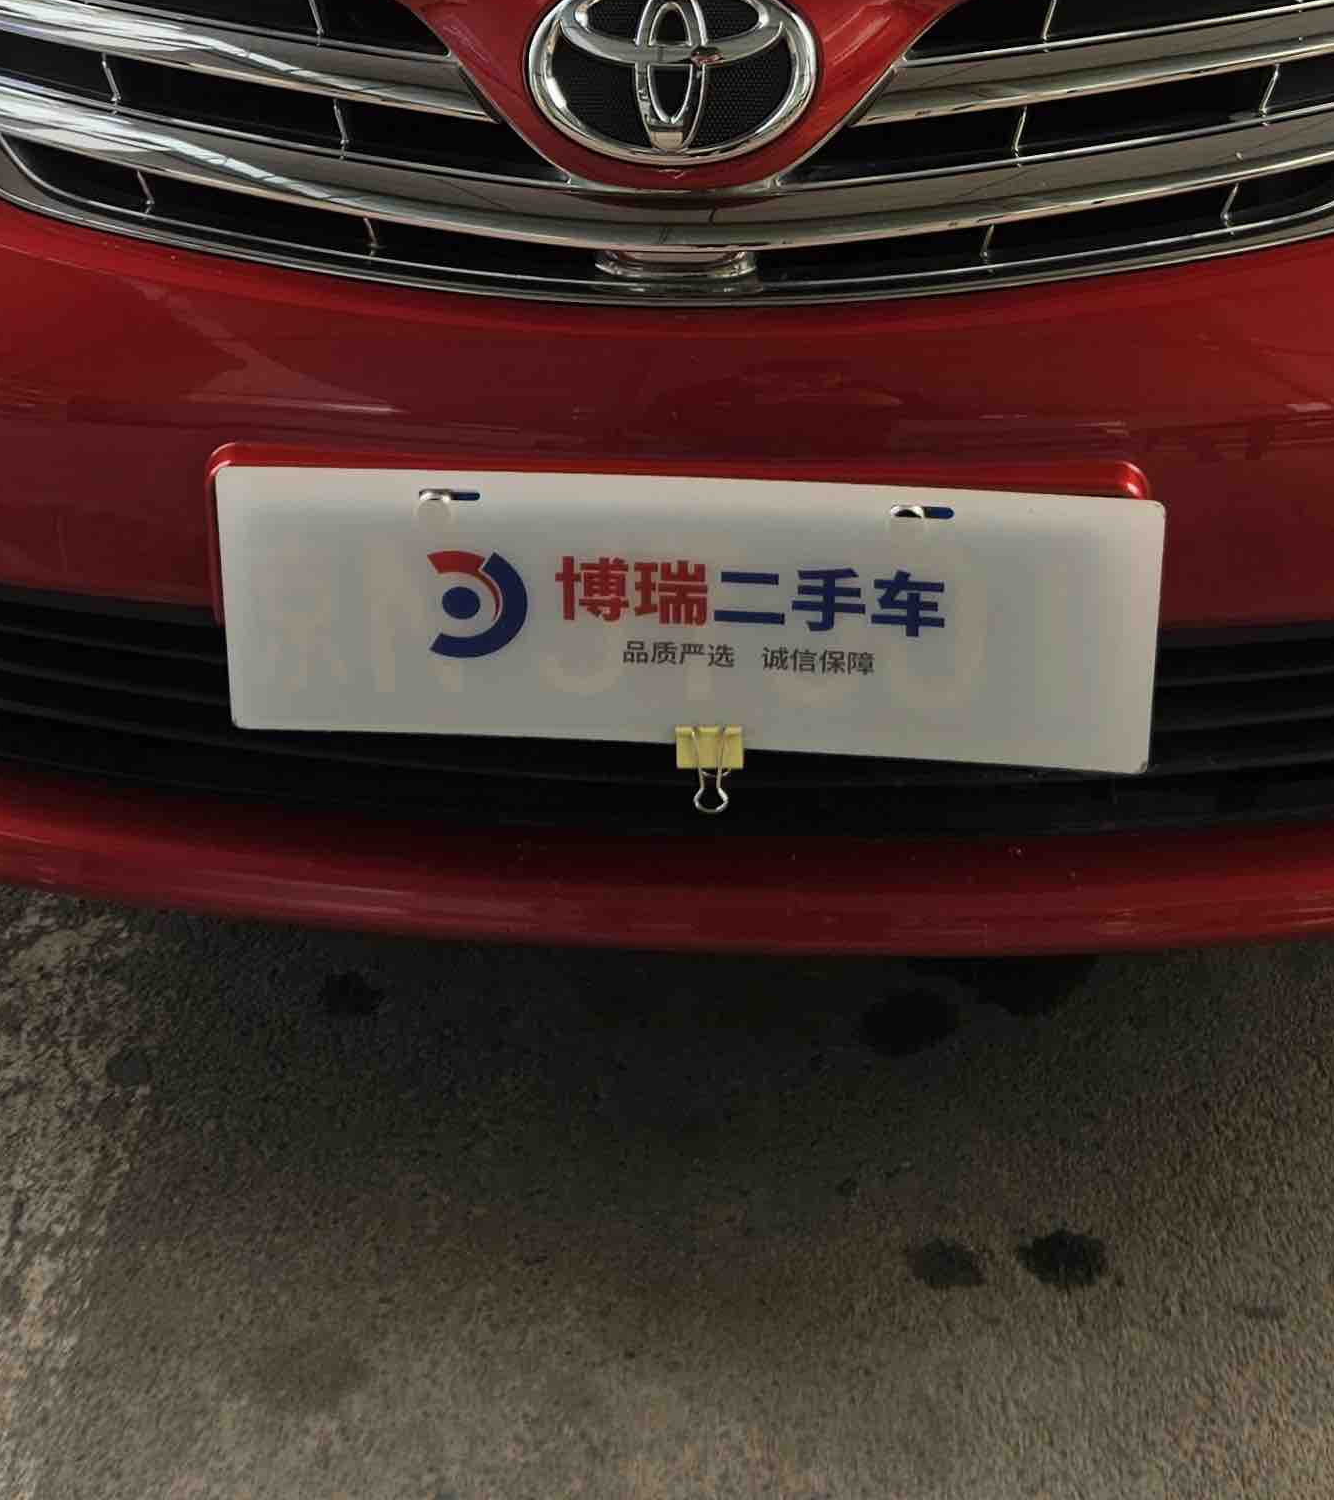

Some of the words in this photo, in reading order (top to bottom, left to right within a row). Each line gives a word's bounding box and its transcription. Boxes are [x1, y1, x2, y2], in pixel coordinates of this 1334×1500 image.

[555, 556, 945, 637] 博瑞二手车
[622, 640, 735, 669] 品质严选
[762, 646, 875, 676] 诚信保障
